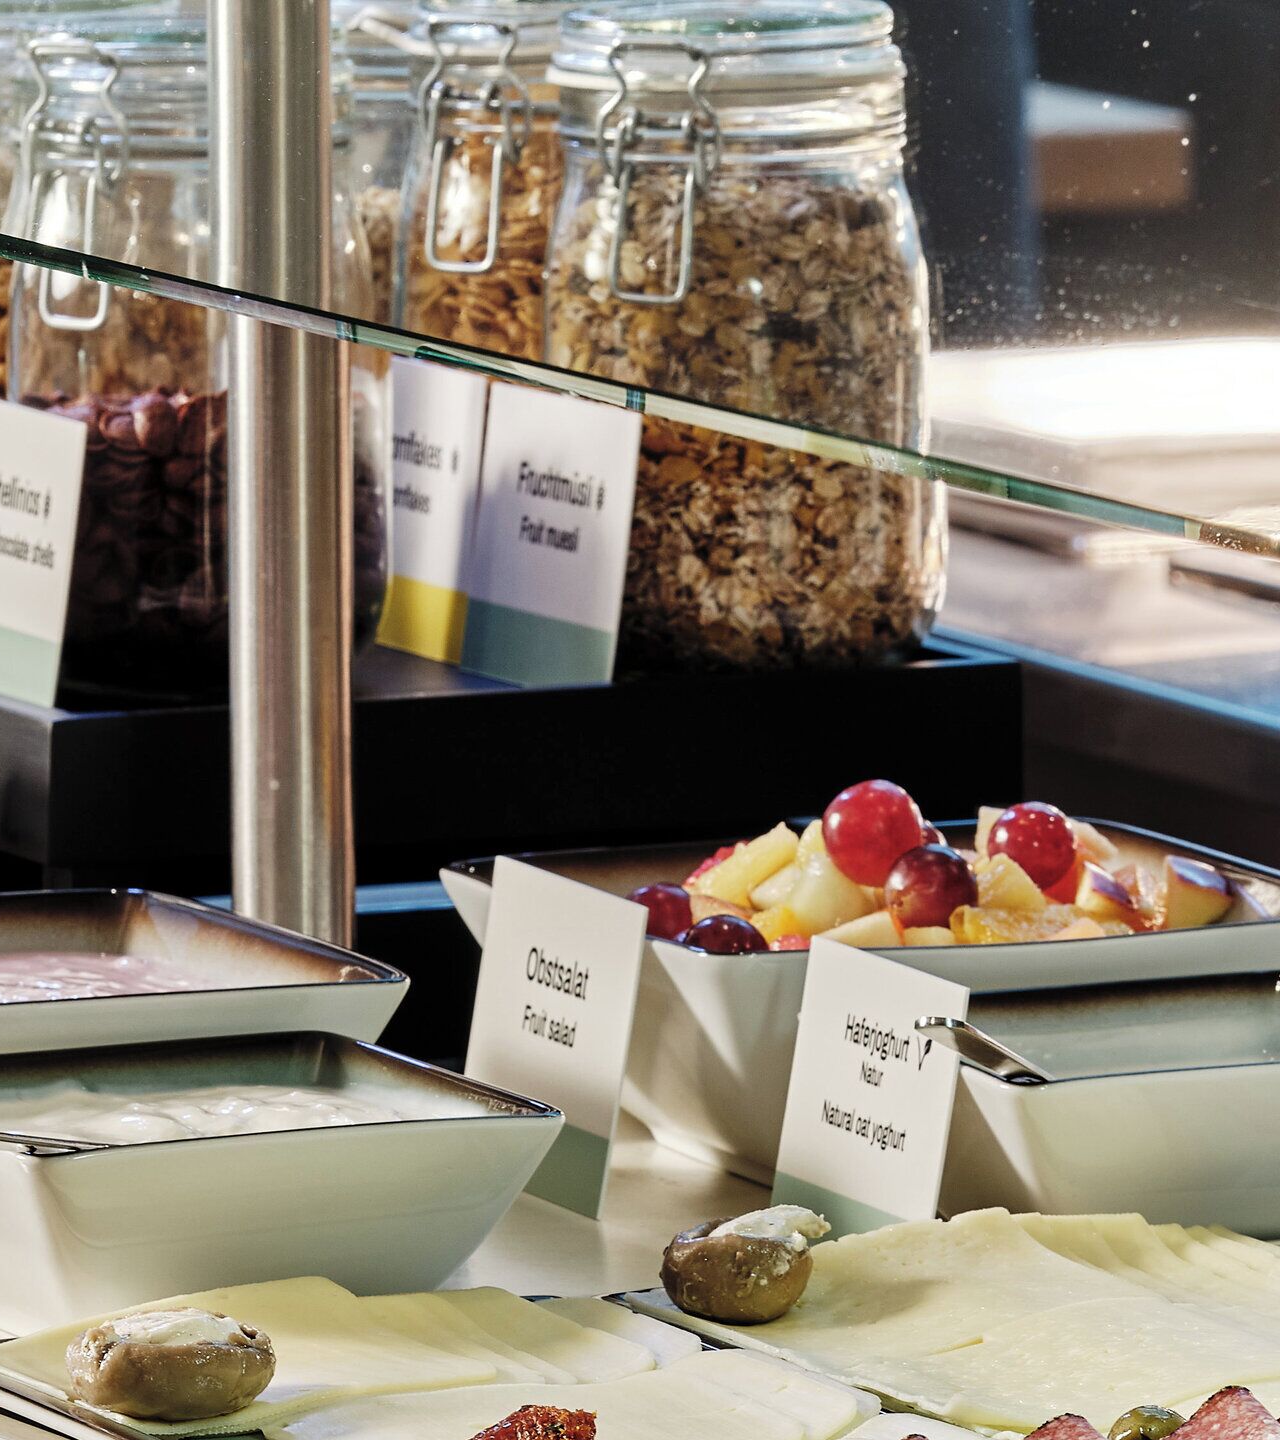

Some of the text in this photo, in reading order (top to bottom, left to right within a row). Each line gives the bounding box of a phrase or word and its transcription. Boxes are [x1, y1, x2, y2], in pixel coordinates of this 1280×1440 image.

[519, 515, 544, 545] Fruit
[526, 947, 588, 1000] Obstsalat
[522, 1004, 577, 1048] Fruit salad
[845, 1013, 910, 1061] Haferjoghurt
[860, 1060, 884, 1087] Natur
[821, 1099, 907, 1152] Natural oat yoghurt
